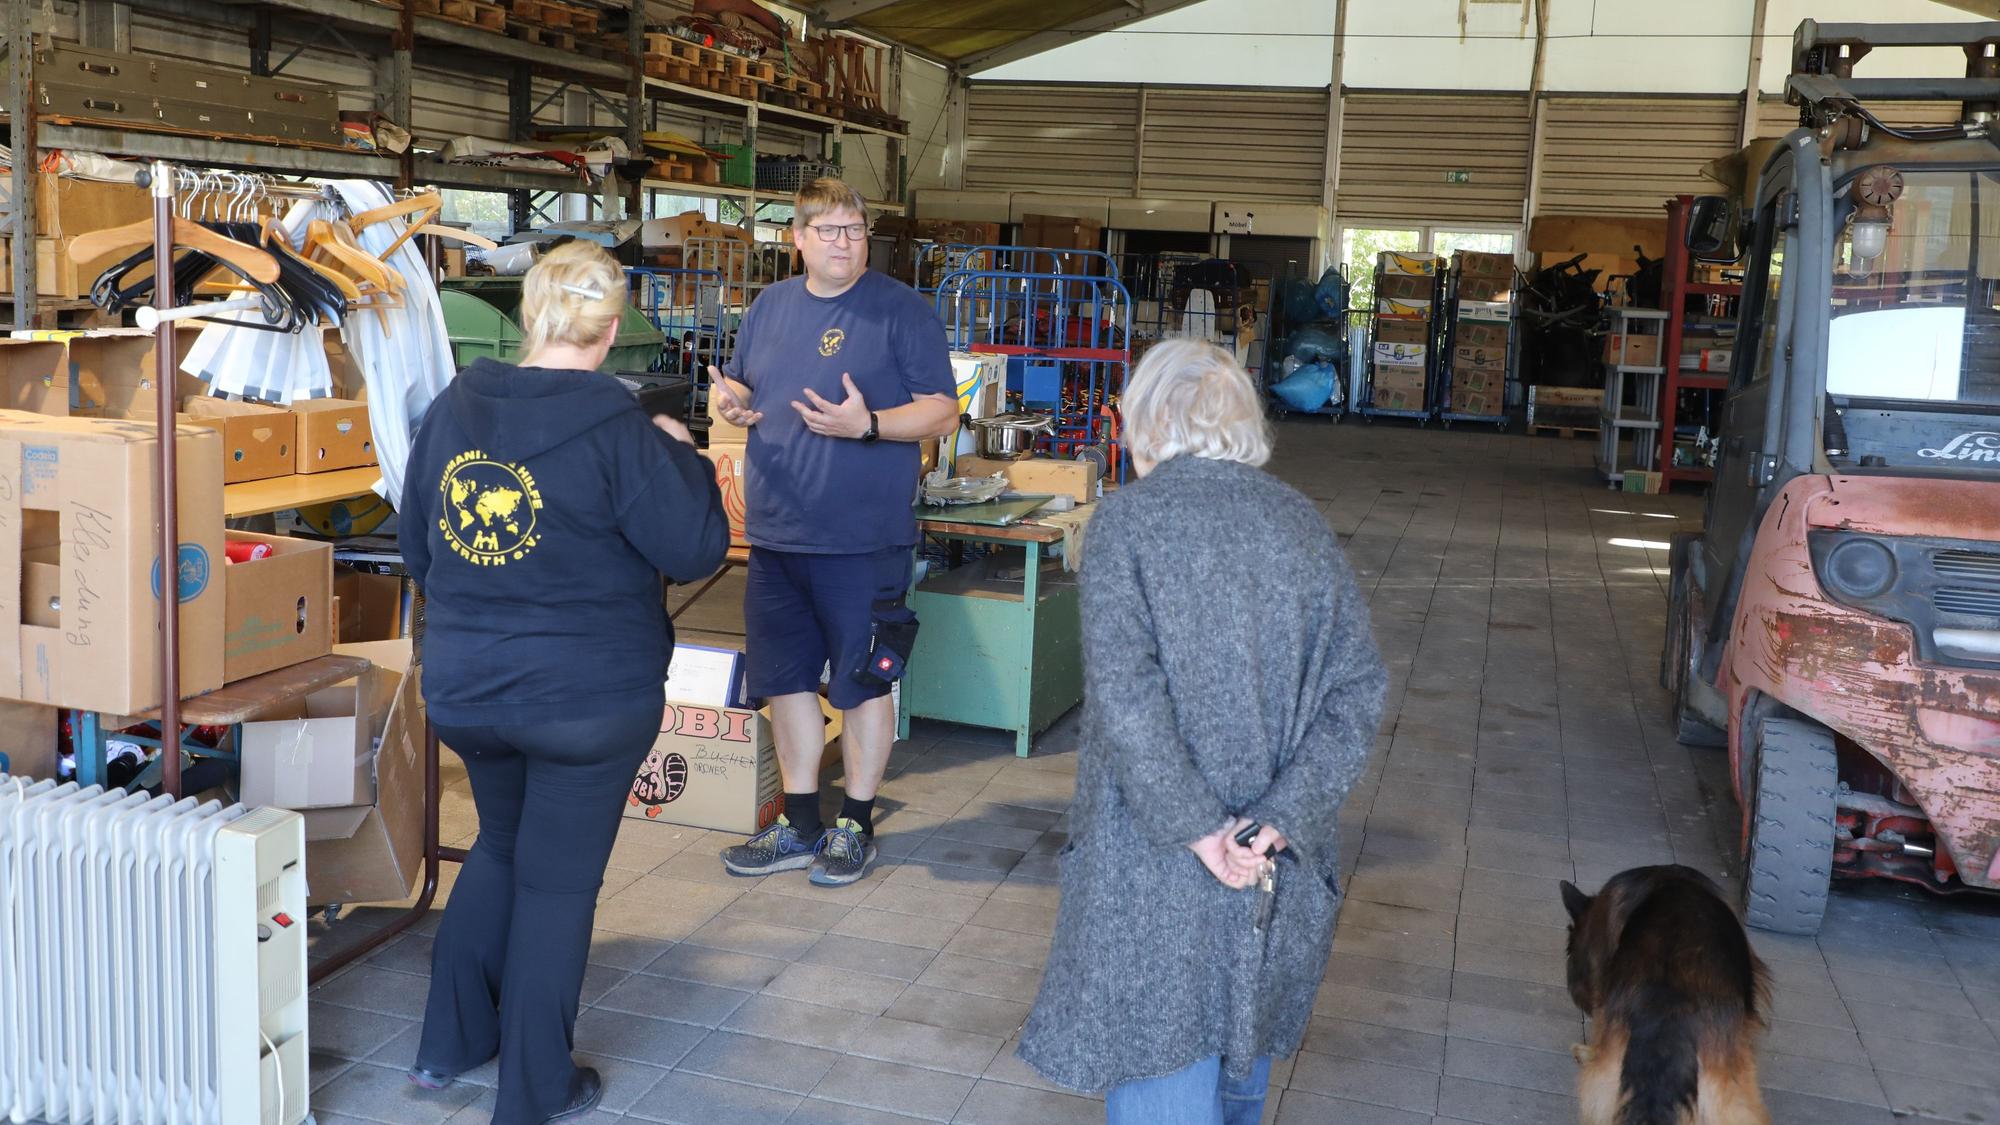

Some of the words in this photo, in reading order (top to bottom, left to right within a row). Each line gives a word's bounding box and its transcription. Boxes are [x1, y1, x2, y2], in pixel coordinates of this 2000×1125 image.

[1917, 431, 2000, 462] Lin
[516, 466, 543, 509] HILFE
[438, 518, 506, 566] OVERATH
[66, 501, 113, 647] Kleidung
[633, 778, 655, 800] OBI
